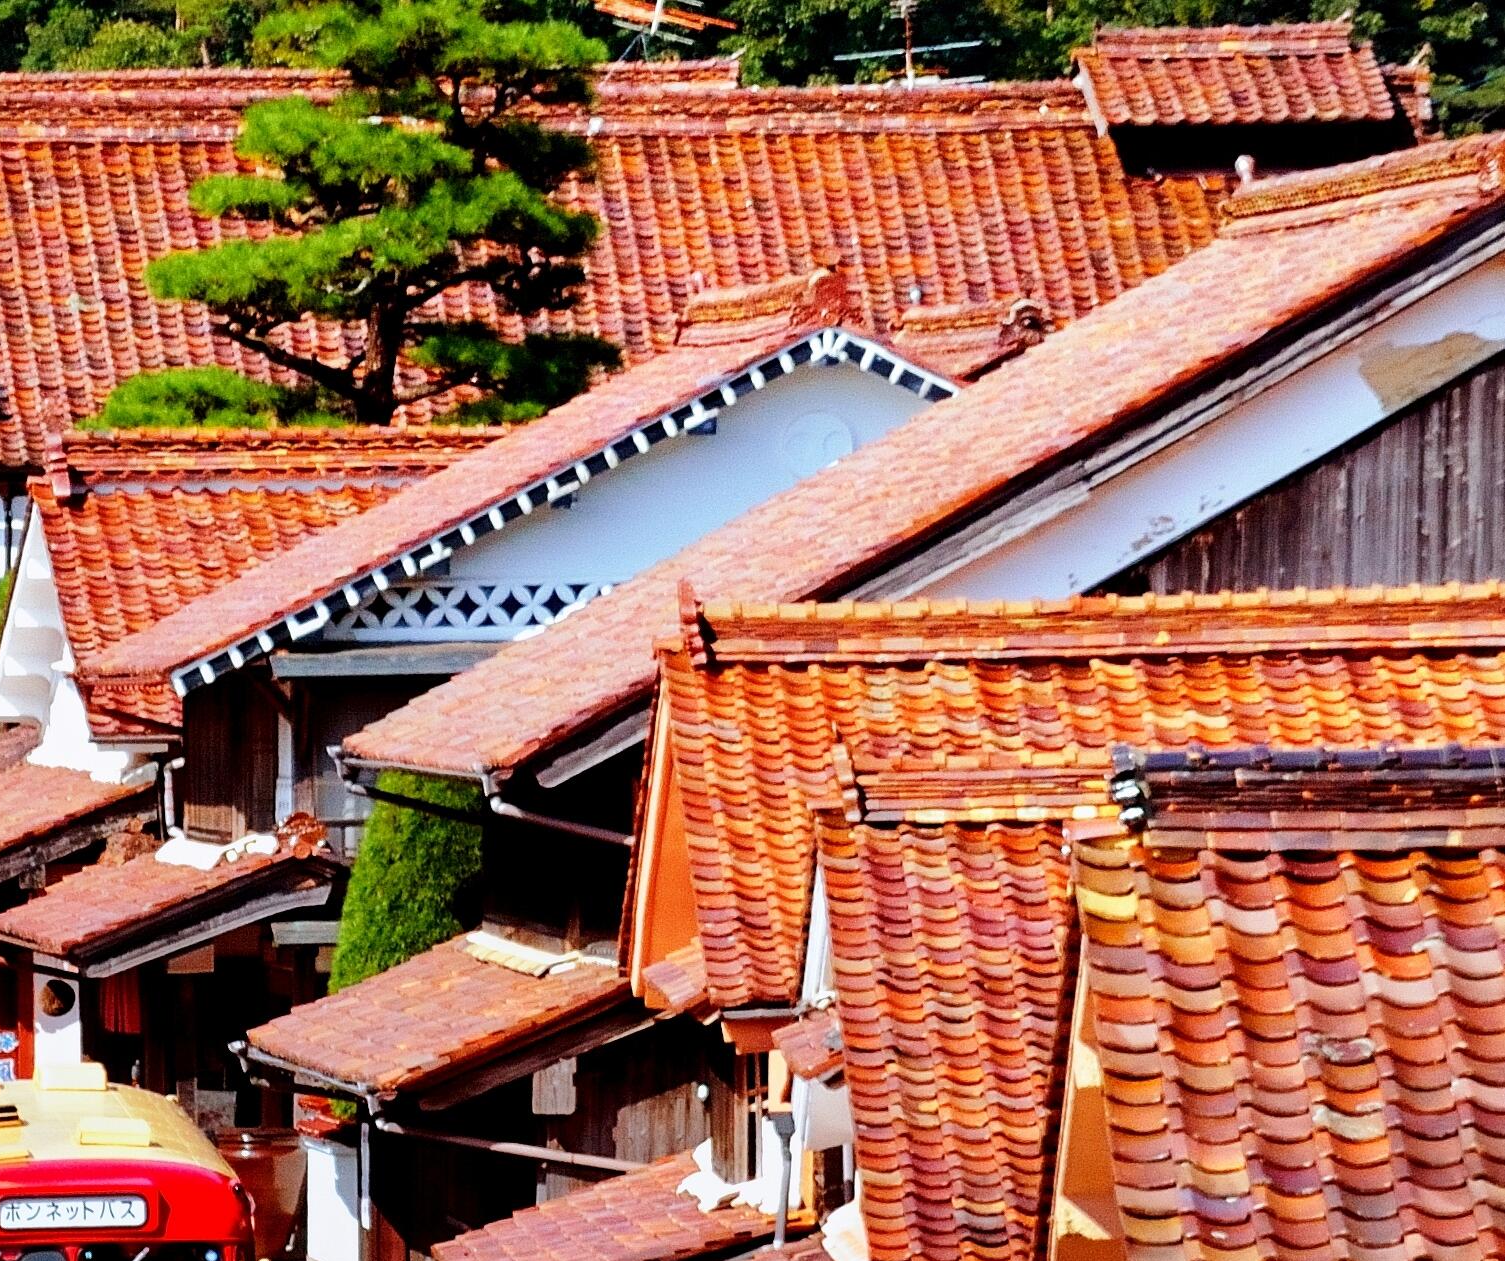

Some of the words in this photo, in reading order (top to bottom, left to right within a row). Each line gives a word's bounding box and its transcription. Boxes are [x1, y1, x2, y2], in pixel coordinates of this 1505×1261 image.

[5, 1199, 137, 1223] ボンネットバス
